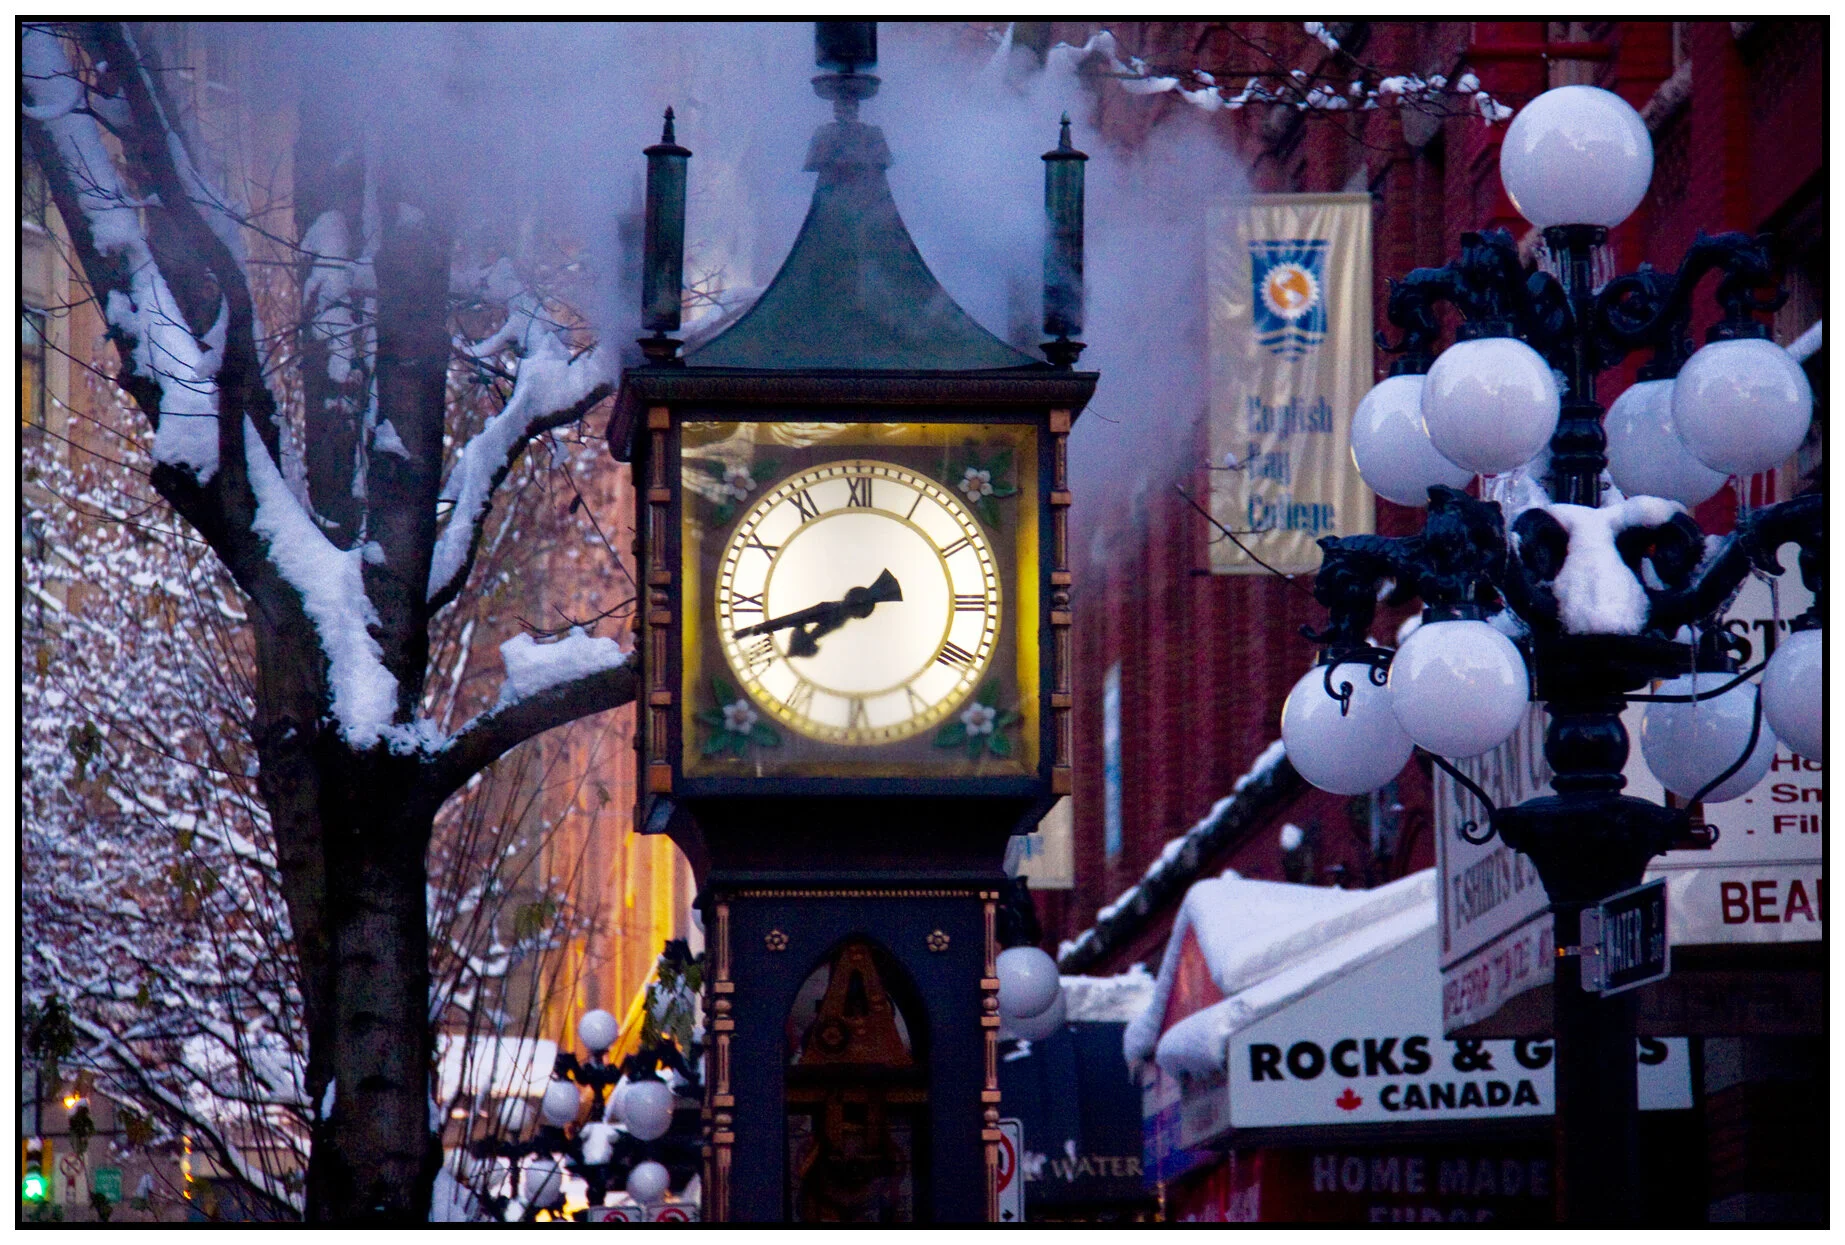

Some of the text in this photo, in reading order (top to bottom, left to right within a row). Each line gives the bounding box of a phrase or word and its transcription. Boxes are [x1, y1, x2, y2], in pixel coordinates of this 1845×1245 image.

[1247, 396, 1333, 440] English
[1247, 494, 1336, 536] College
[1770, 753, 1822, 772] Ho
[1773, 815, 1819, 834] Fil
[1720, 880, 1822, 925] BEA
[1250, 1037, 1430, 1082] ROCKS
[1453, 1039, 1495, 1072] &
[1378, 1079, 1539, 1112] CANADA
[1050, 1156, 1144, 1180] WATER
[1311, 1156, 1547, 1199] HOME MADE
